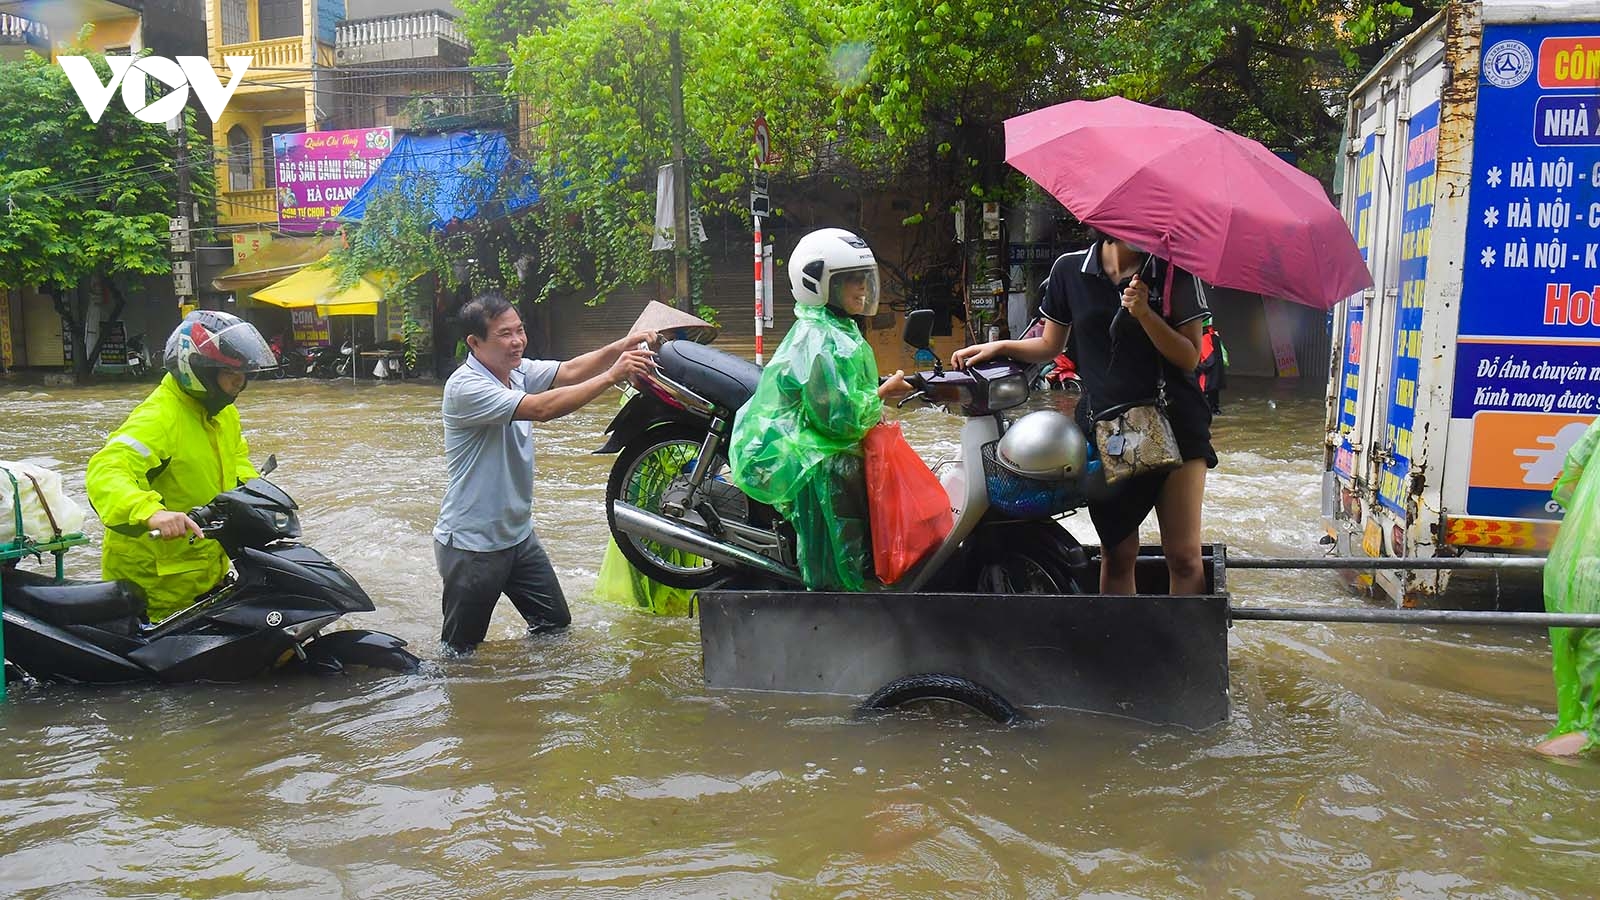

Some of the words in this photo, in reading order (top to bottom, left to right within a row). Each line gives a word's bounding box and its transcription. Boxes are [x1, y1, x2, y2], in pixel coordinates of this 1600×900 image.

[1544, 103, 1589, 137] NHÀ
[317, 155, 341, 181] BÁNH
[1510, 156, 1535, 187] HÀ
[1540, 156, 1574, 193] NỘI
[306, 184, 323, 202] HÀ
[1507, 197, 1532, 228] HÀ
[1537, 197, 1571, 234] NỘI
[1504, 237, 1529, 267] HÀ
[1534, 237, 1567, 274] NỘI
[1585, 243, 1599, 268] K
[1477, 356, 1500, 378] Đỗ
[1498, 354, 1531, 379] Ánh
[1532, 361, 1587, 385] chuyên
[1474, 386, 1509, 407] Kính
[1512, 392, 1556, 413] mong
[1557, 390, 1595, 415] được
